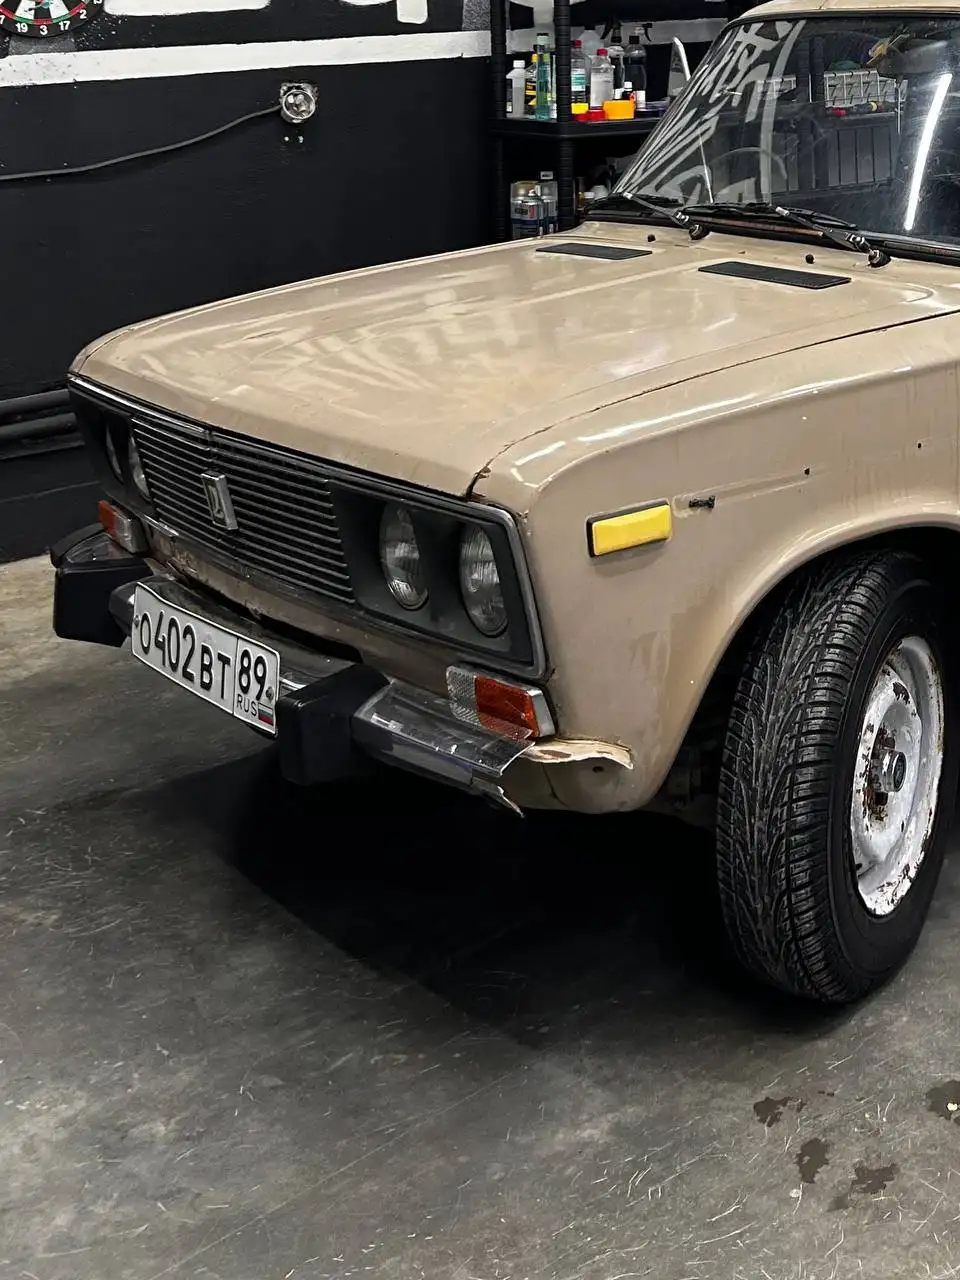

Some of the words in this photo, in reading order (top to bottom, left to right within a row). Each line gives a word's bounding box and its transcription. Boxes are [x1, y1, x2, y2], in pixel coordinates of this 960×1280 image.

[79, 9, 87, 19] 2
[15, 23, 28, 33] 19
[39, 25, 48, 36] 3
[58, 20, 71, 31] 17
[238, 649, 268, 701] 89
[236, 694, 258, 717] RUS
